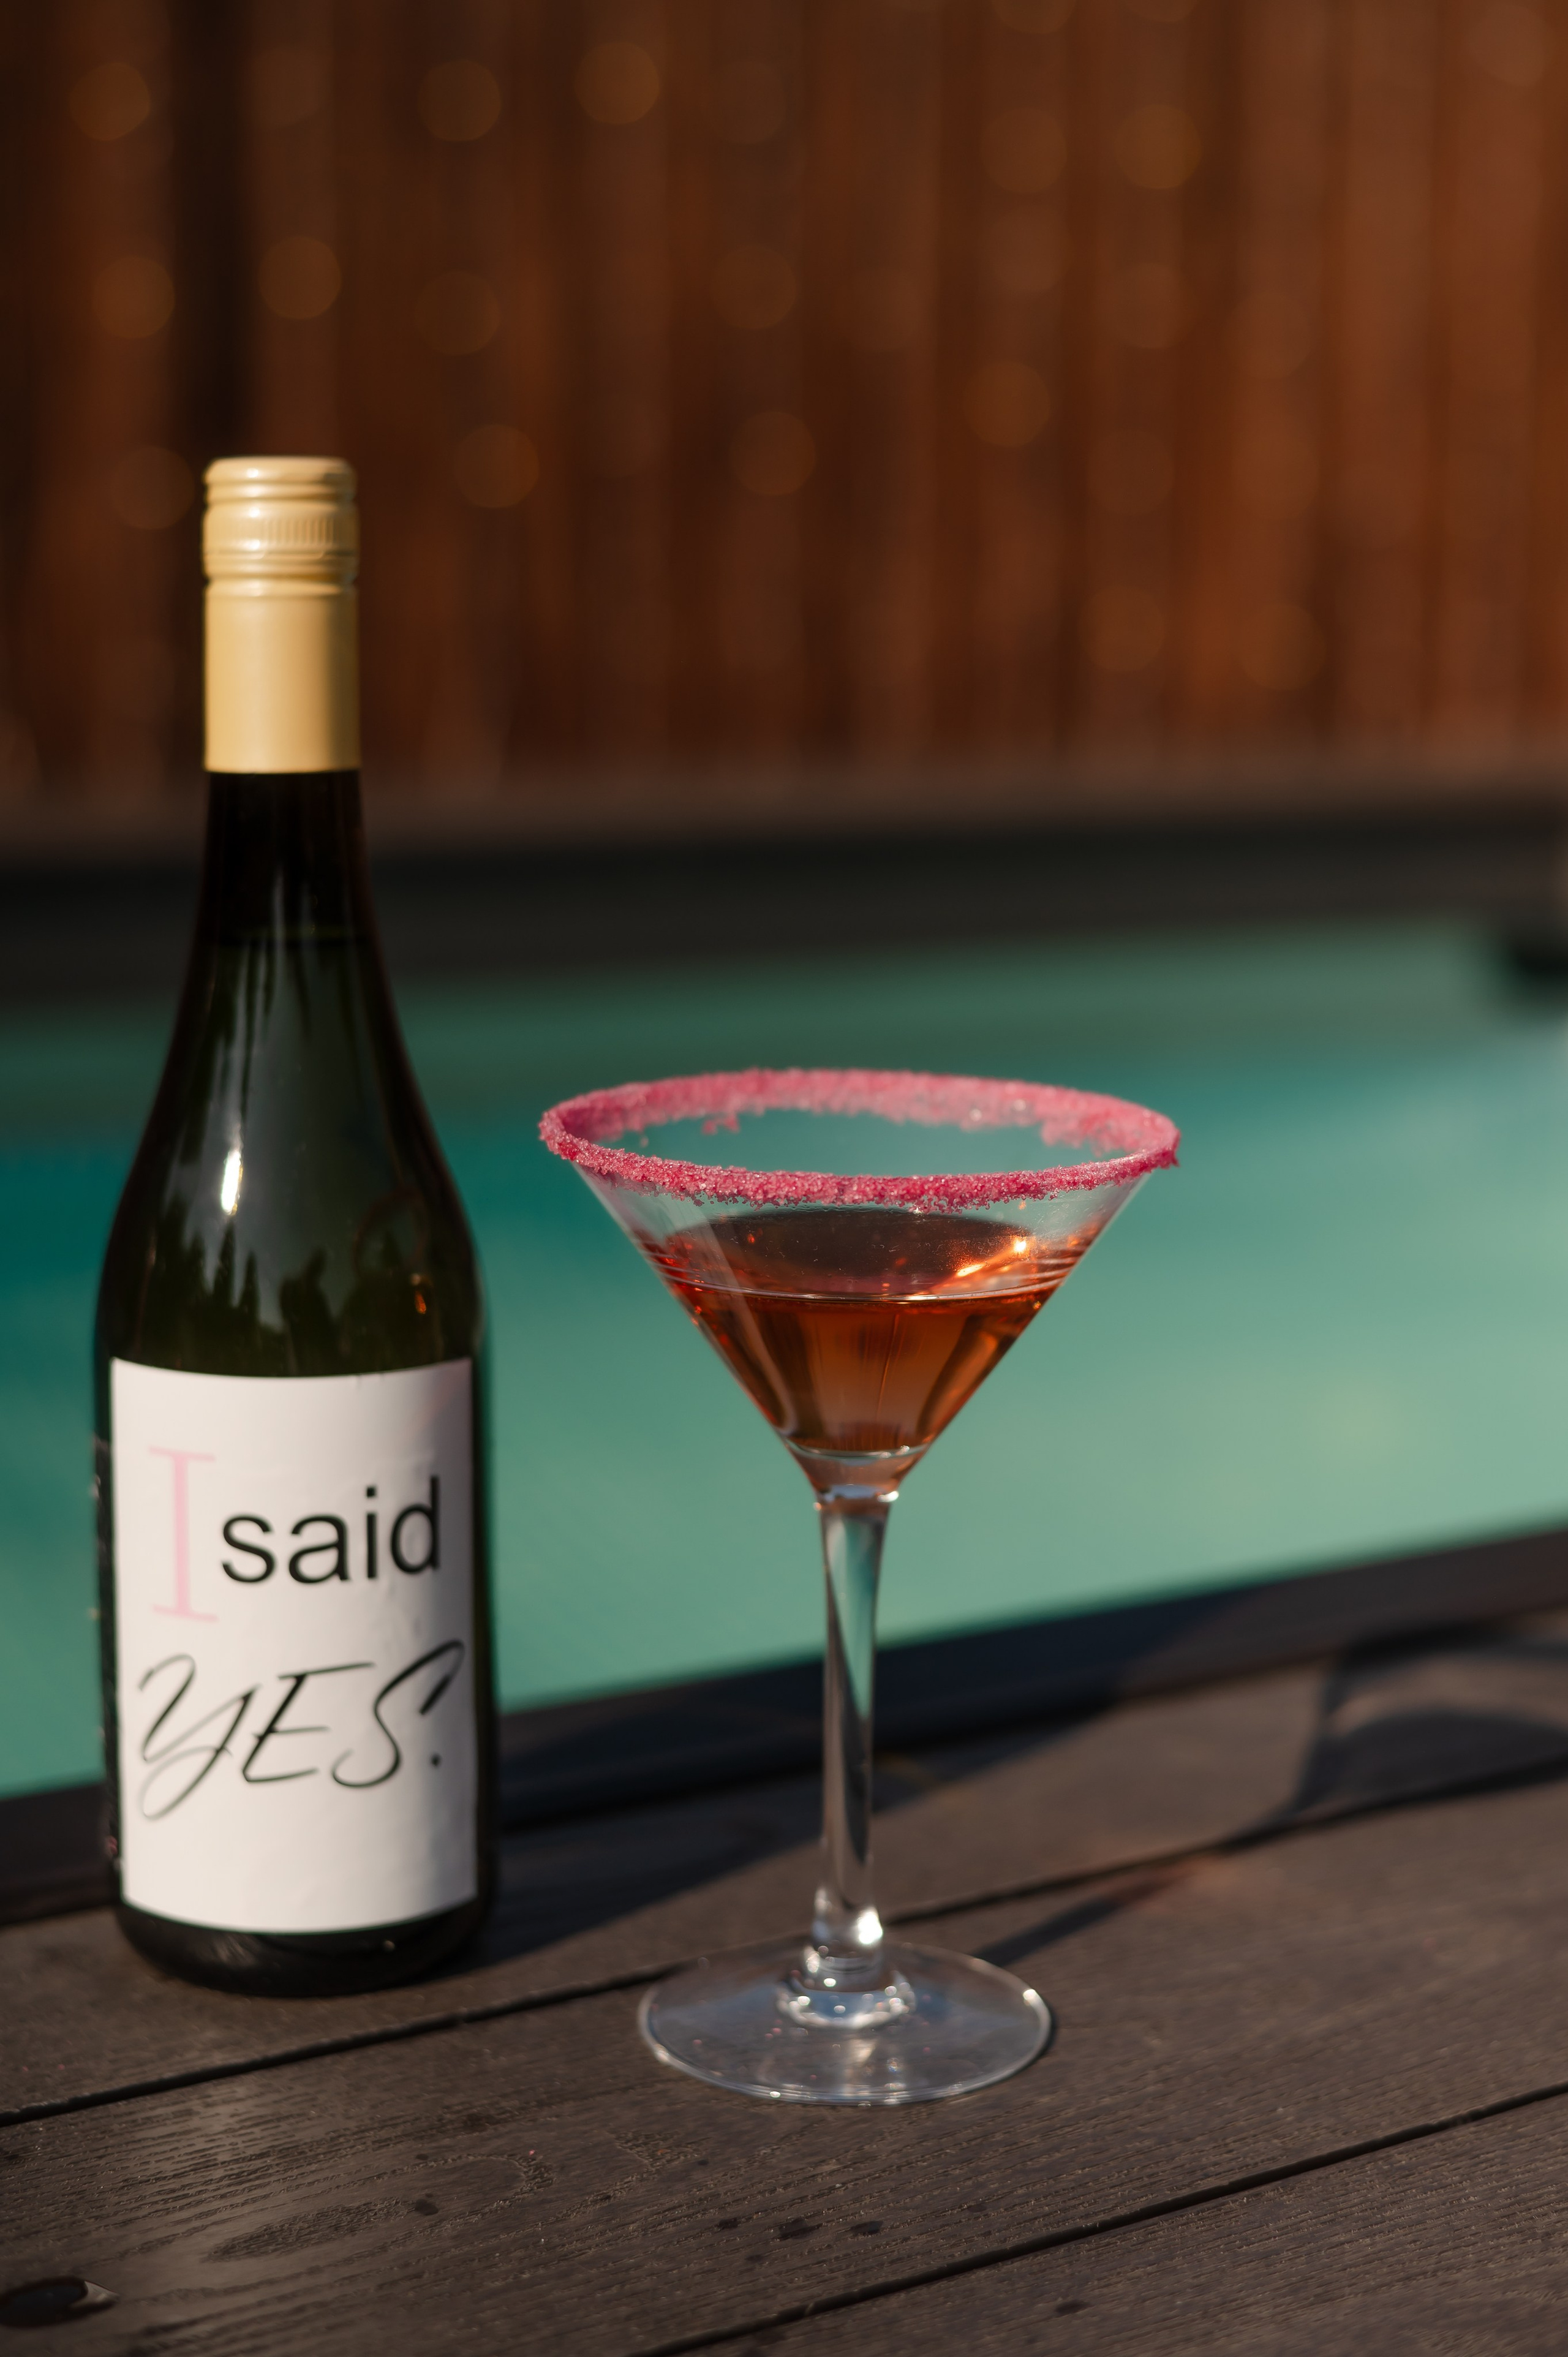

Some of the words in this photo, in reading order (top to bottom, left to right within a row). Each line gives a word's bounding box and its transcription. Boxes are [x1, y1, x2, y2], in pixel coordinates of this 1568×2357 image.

[148, 1446, 219, 1623] I
[221, 1475, 441, 1585] said
[138, 1639, 466, 1821] YES.
